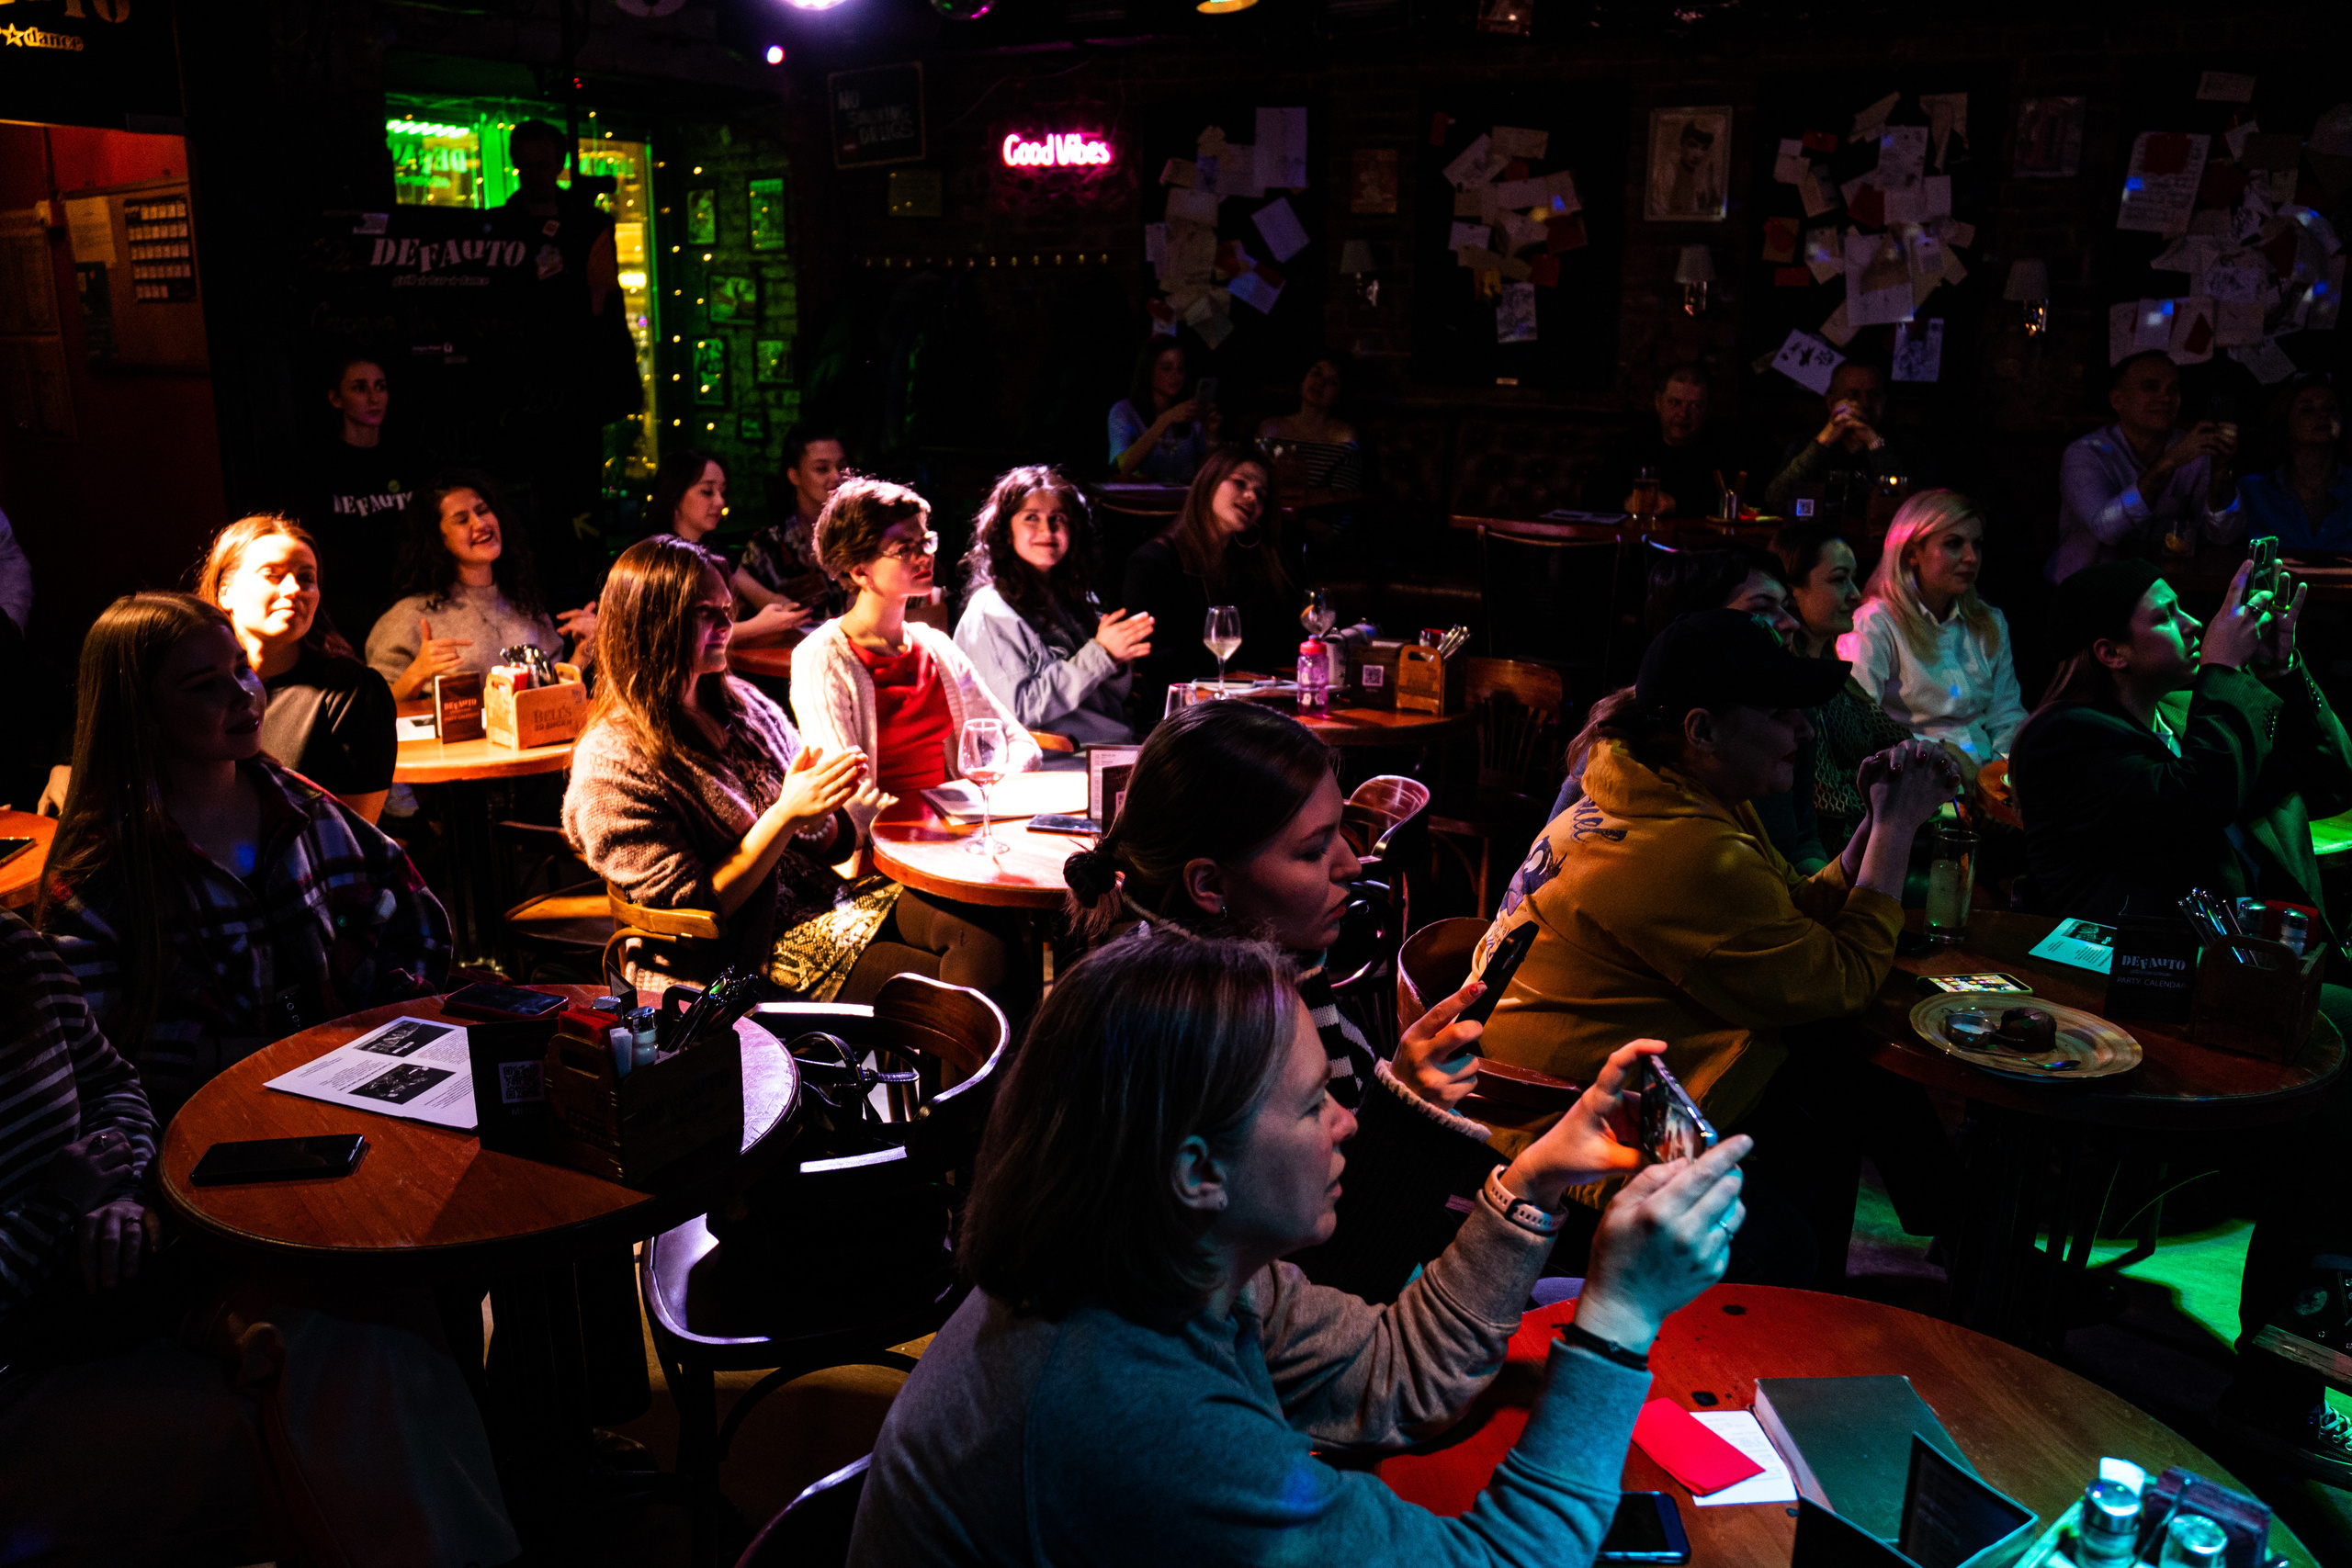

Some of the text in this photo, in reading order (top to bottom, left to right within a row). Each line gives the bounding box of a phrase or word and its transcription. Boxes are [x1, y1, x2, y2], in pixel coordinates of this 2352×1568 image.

[23, 26, 85, 52] dance
[1002, 133, 1111, 166] Good Vibes
[369, 238, 527, 274] DEFAUTO
[333, 491, 413, 518] EFAUT
[2121, 954, 2187, 971] DEFAUTO
[2116, 976, 2143, 986] PARTY
